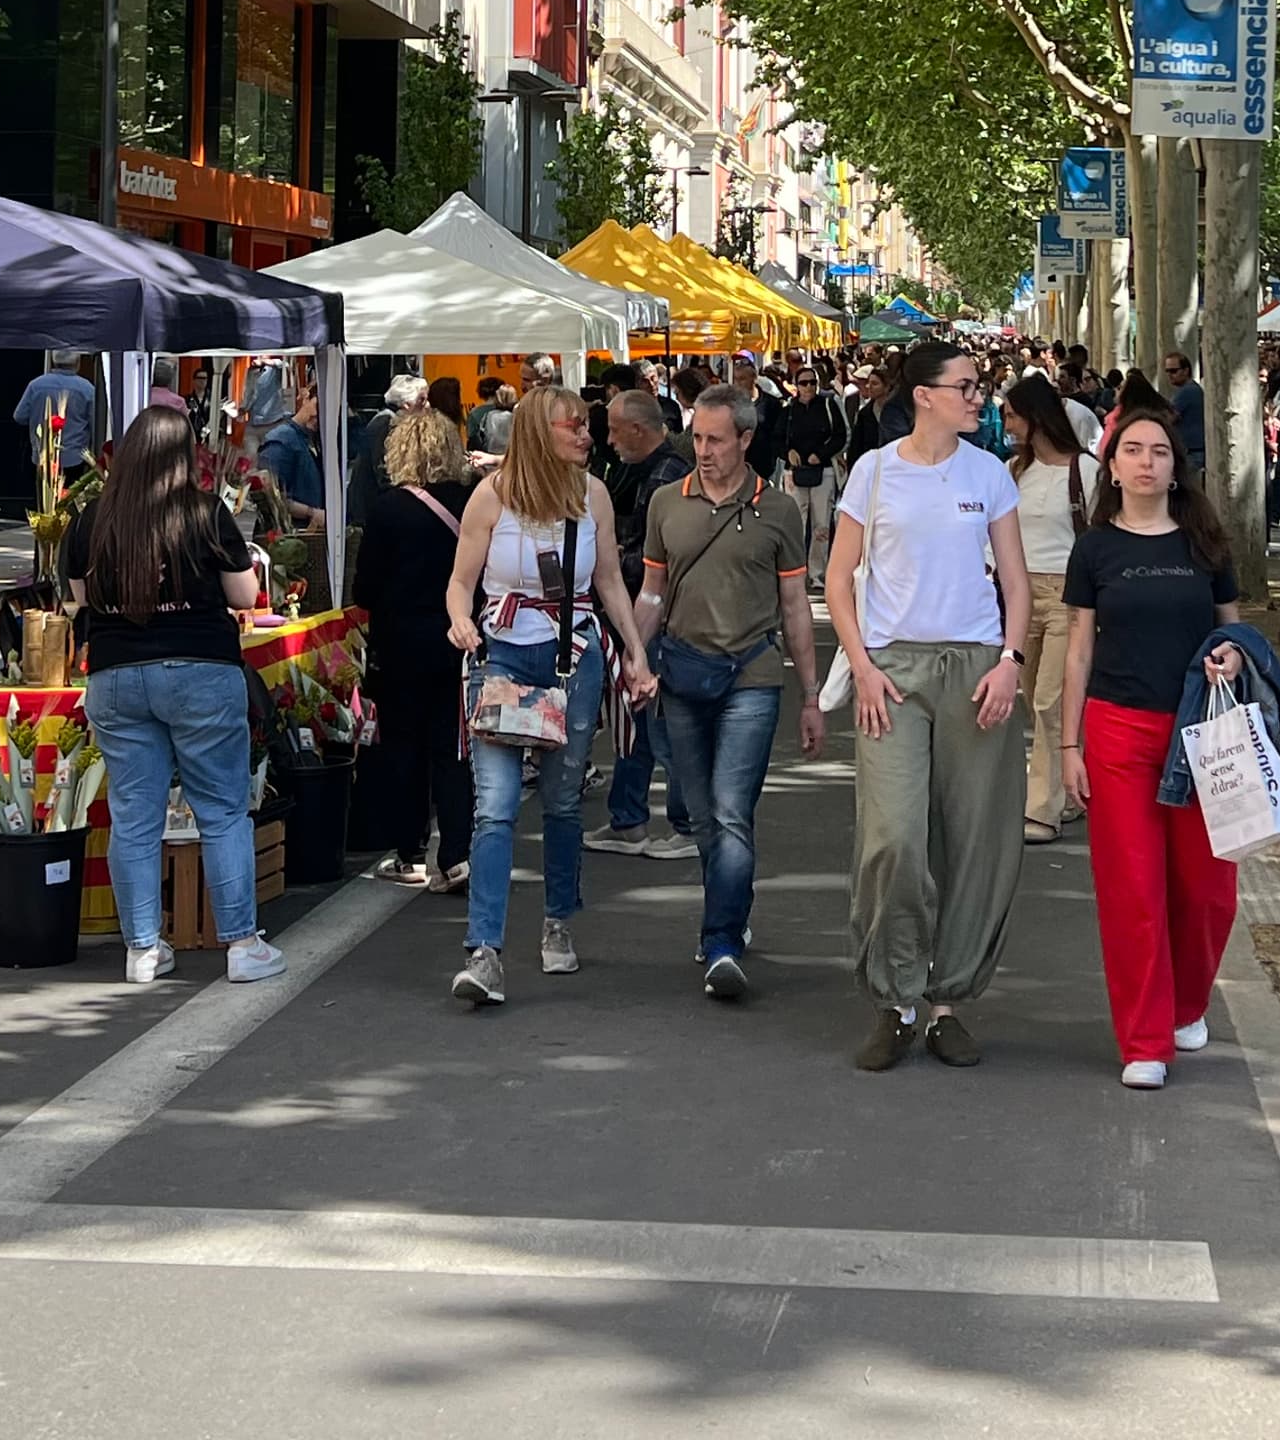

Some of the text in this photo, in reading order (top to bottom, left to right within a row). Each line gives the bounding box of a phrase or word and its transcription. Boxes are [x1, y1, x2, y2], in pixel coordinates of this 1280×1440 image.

[1139, 37, 1218, 58] L'aigua i
[1140, 59, 1231, 78] la cultura,
[1172, 109, 1237, 128] aqualia
[1217, 743, 1245, 760] farem
